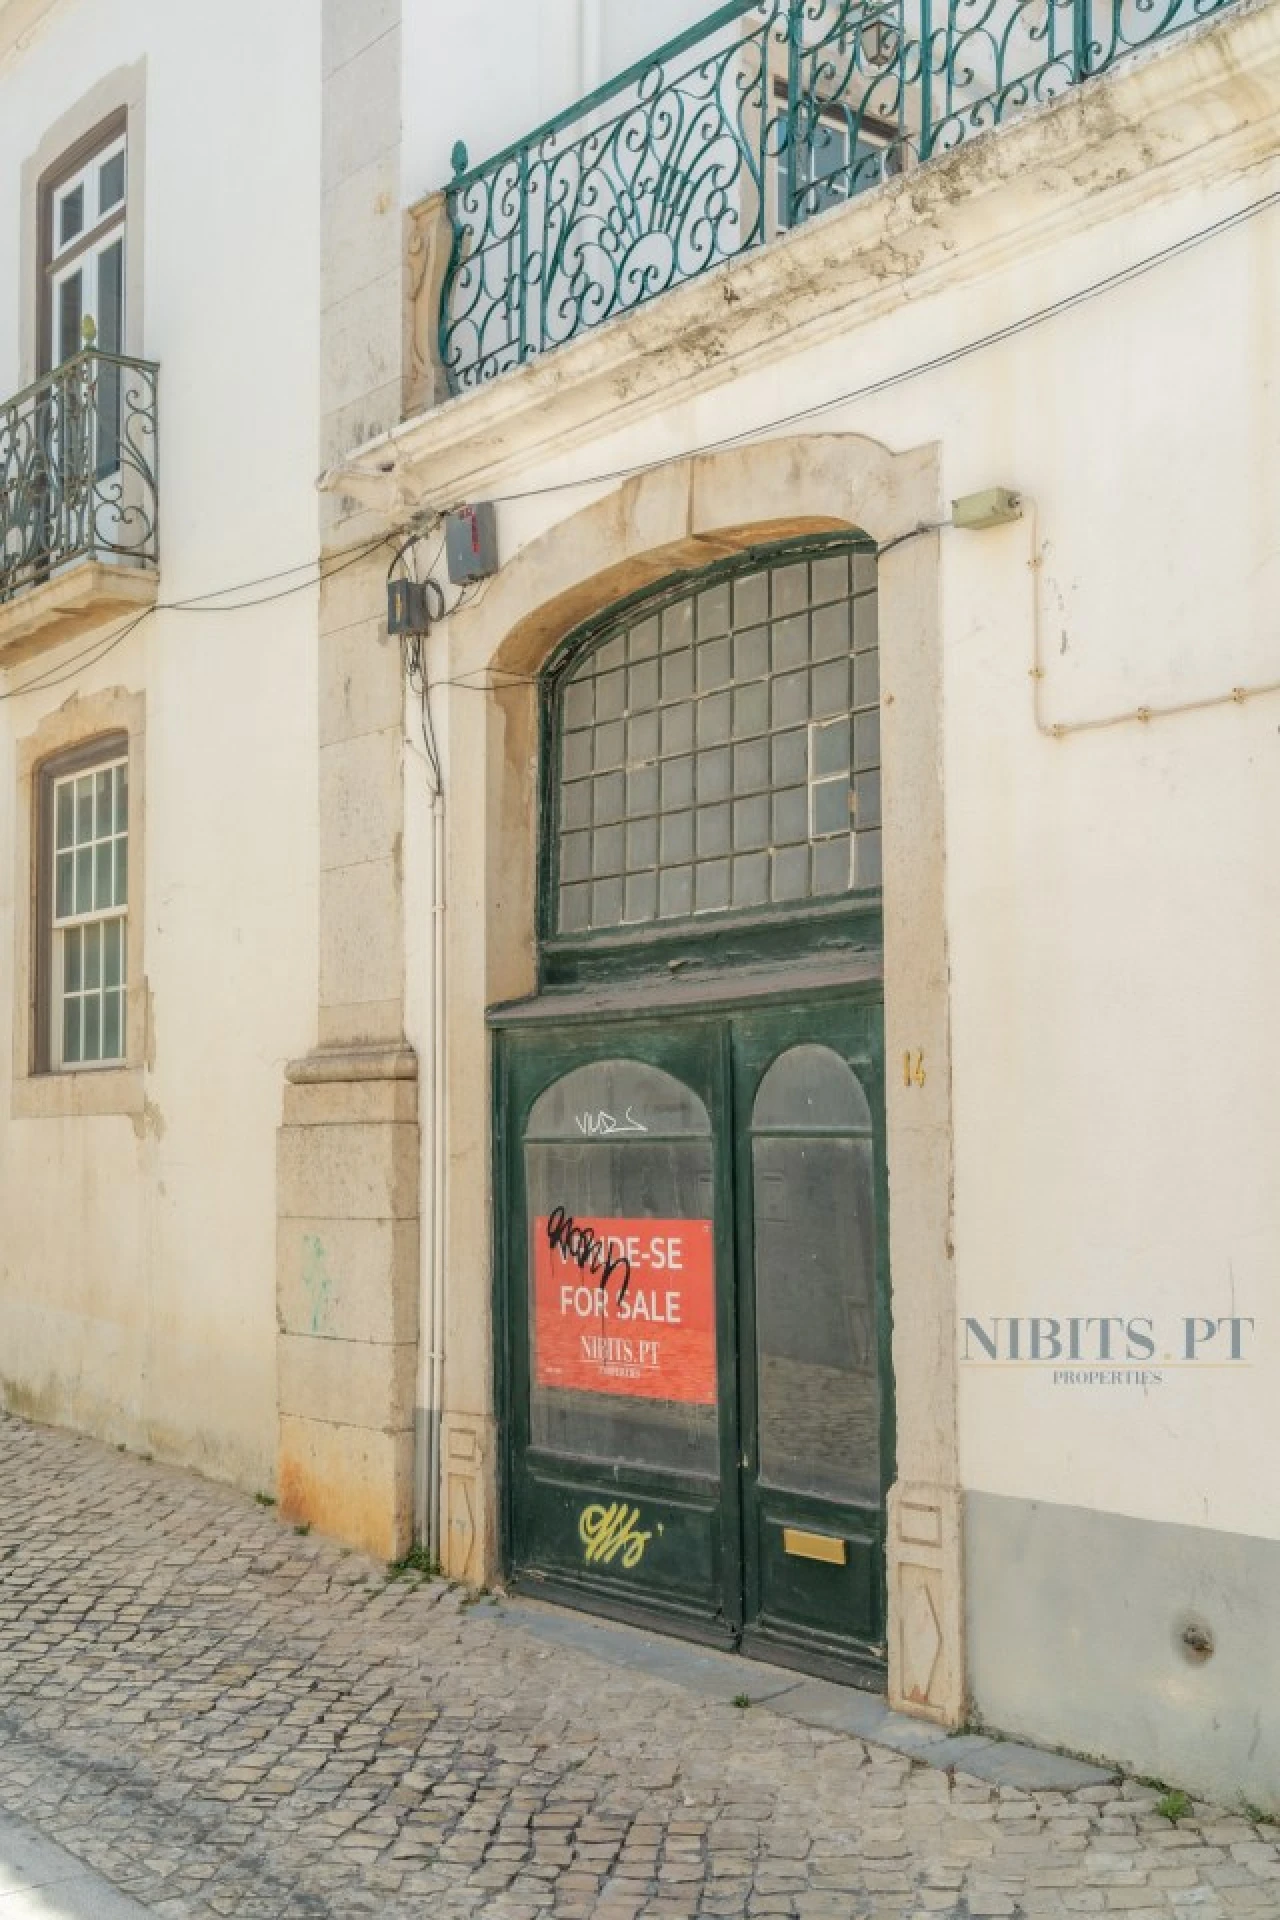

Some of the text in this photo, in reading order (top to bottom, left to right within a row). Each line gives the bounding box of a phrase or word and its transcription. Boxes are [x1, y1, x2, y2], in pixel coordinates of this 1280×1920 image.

[903, 1051, 926, 1088] 14
[560, 1285, 681, 1322] FOR SALE
